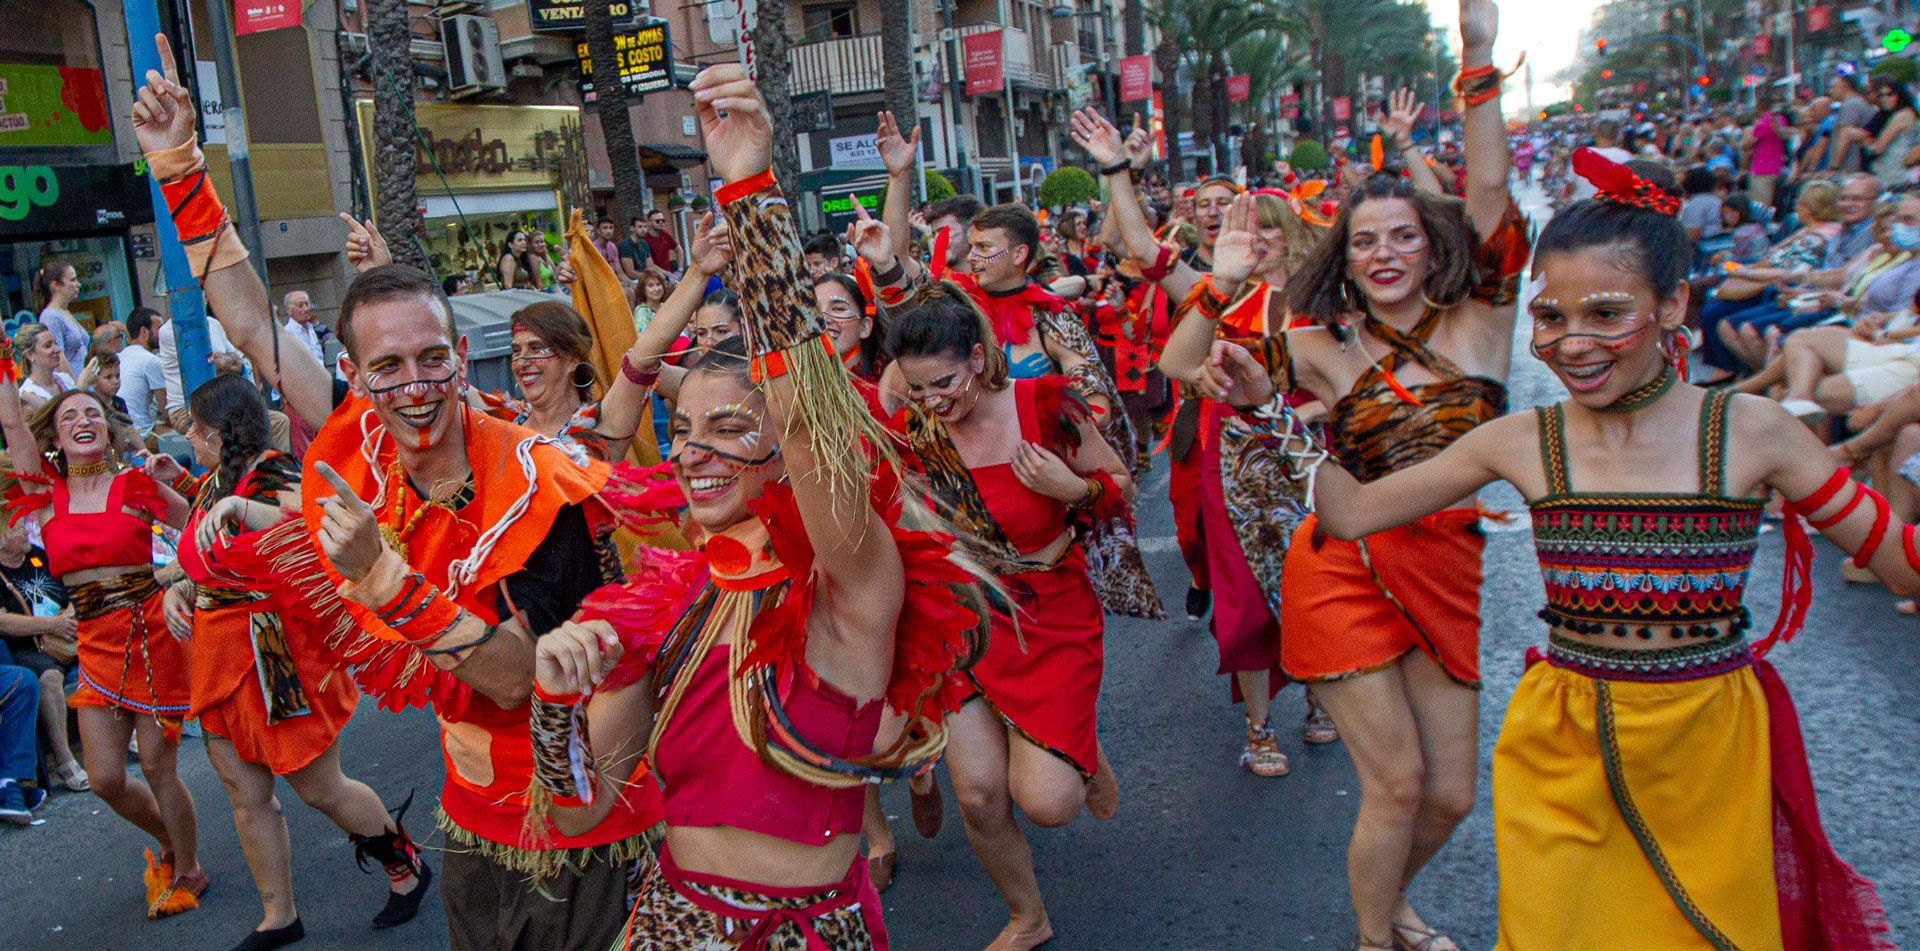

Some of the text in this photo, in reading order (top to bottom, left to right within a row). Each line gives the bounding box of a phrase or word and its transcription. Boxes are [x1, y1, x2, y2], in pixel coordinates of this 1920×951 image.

[637, 28, 664, 46] JOYAS
[628, 45, 663, 65] COSTO
[836, 142, 852, 152] SE
